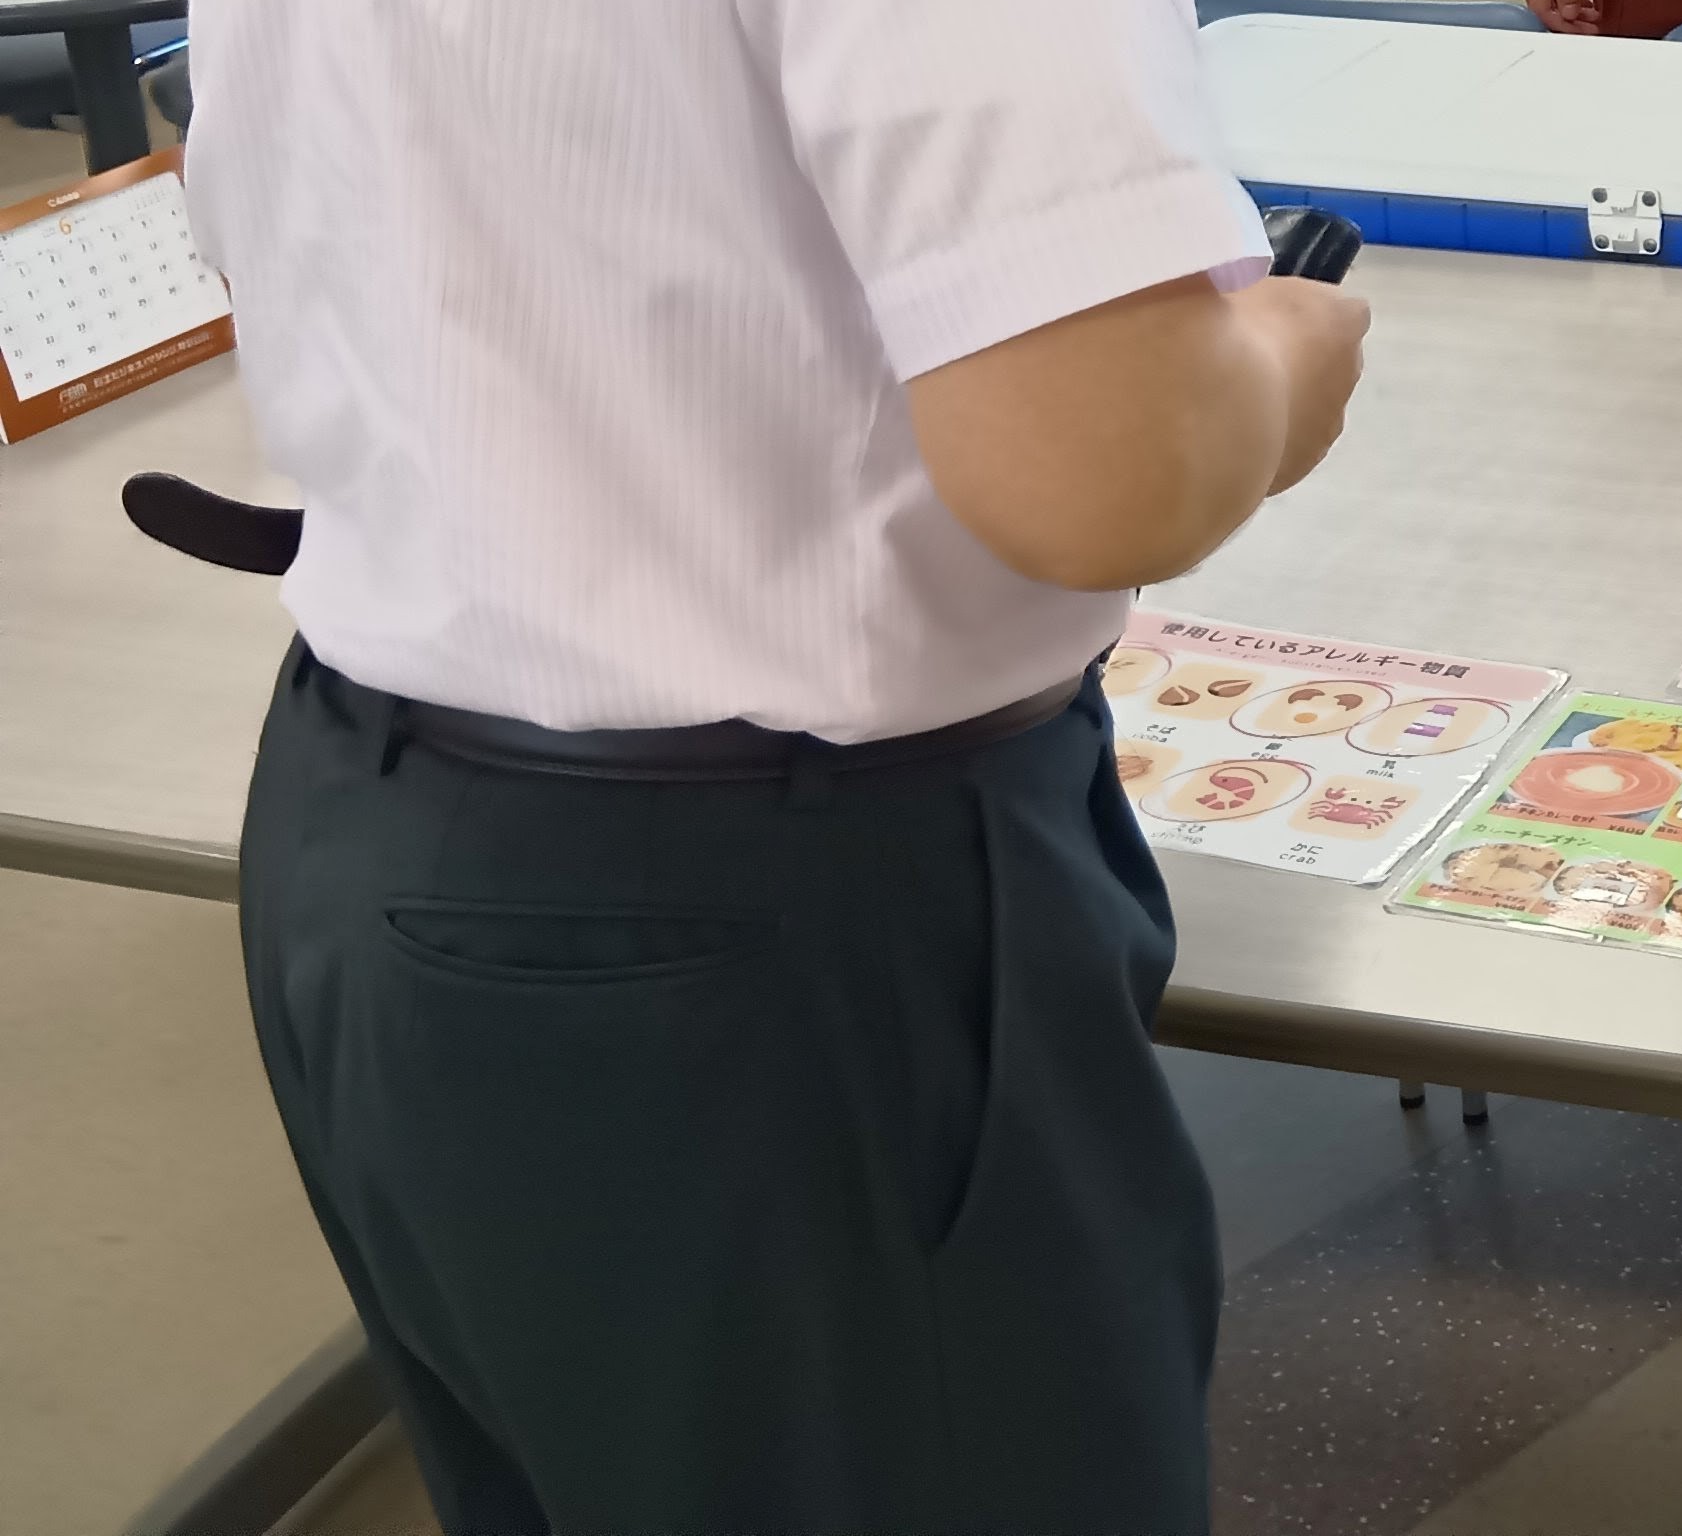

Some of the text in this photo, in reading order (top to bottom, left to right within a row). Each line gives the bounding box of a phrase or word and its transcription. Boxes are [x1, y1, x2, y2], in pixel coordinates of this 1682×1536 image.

[58, 217, 72, 235] 6
[1160, 622, 1471, 678] 使用しているアレルギー物質
[1472, 824, 1593, 847] カレーチーズナン
[1279, 852, 1316, 866] crab
